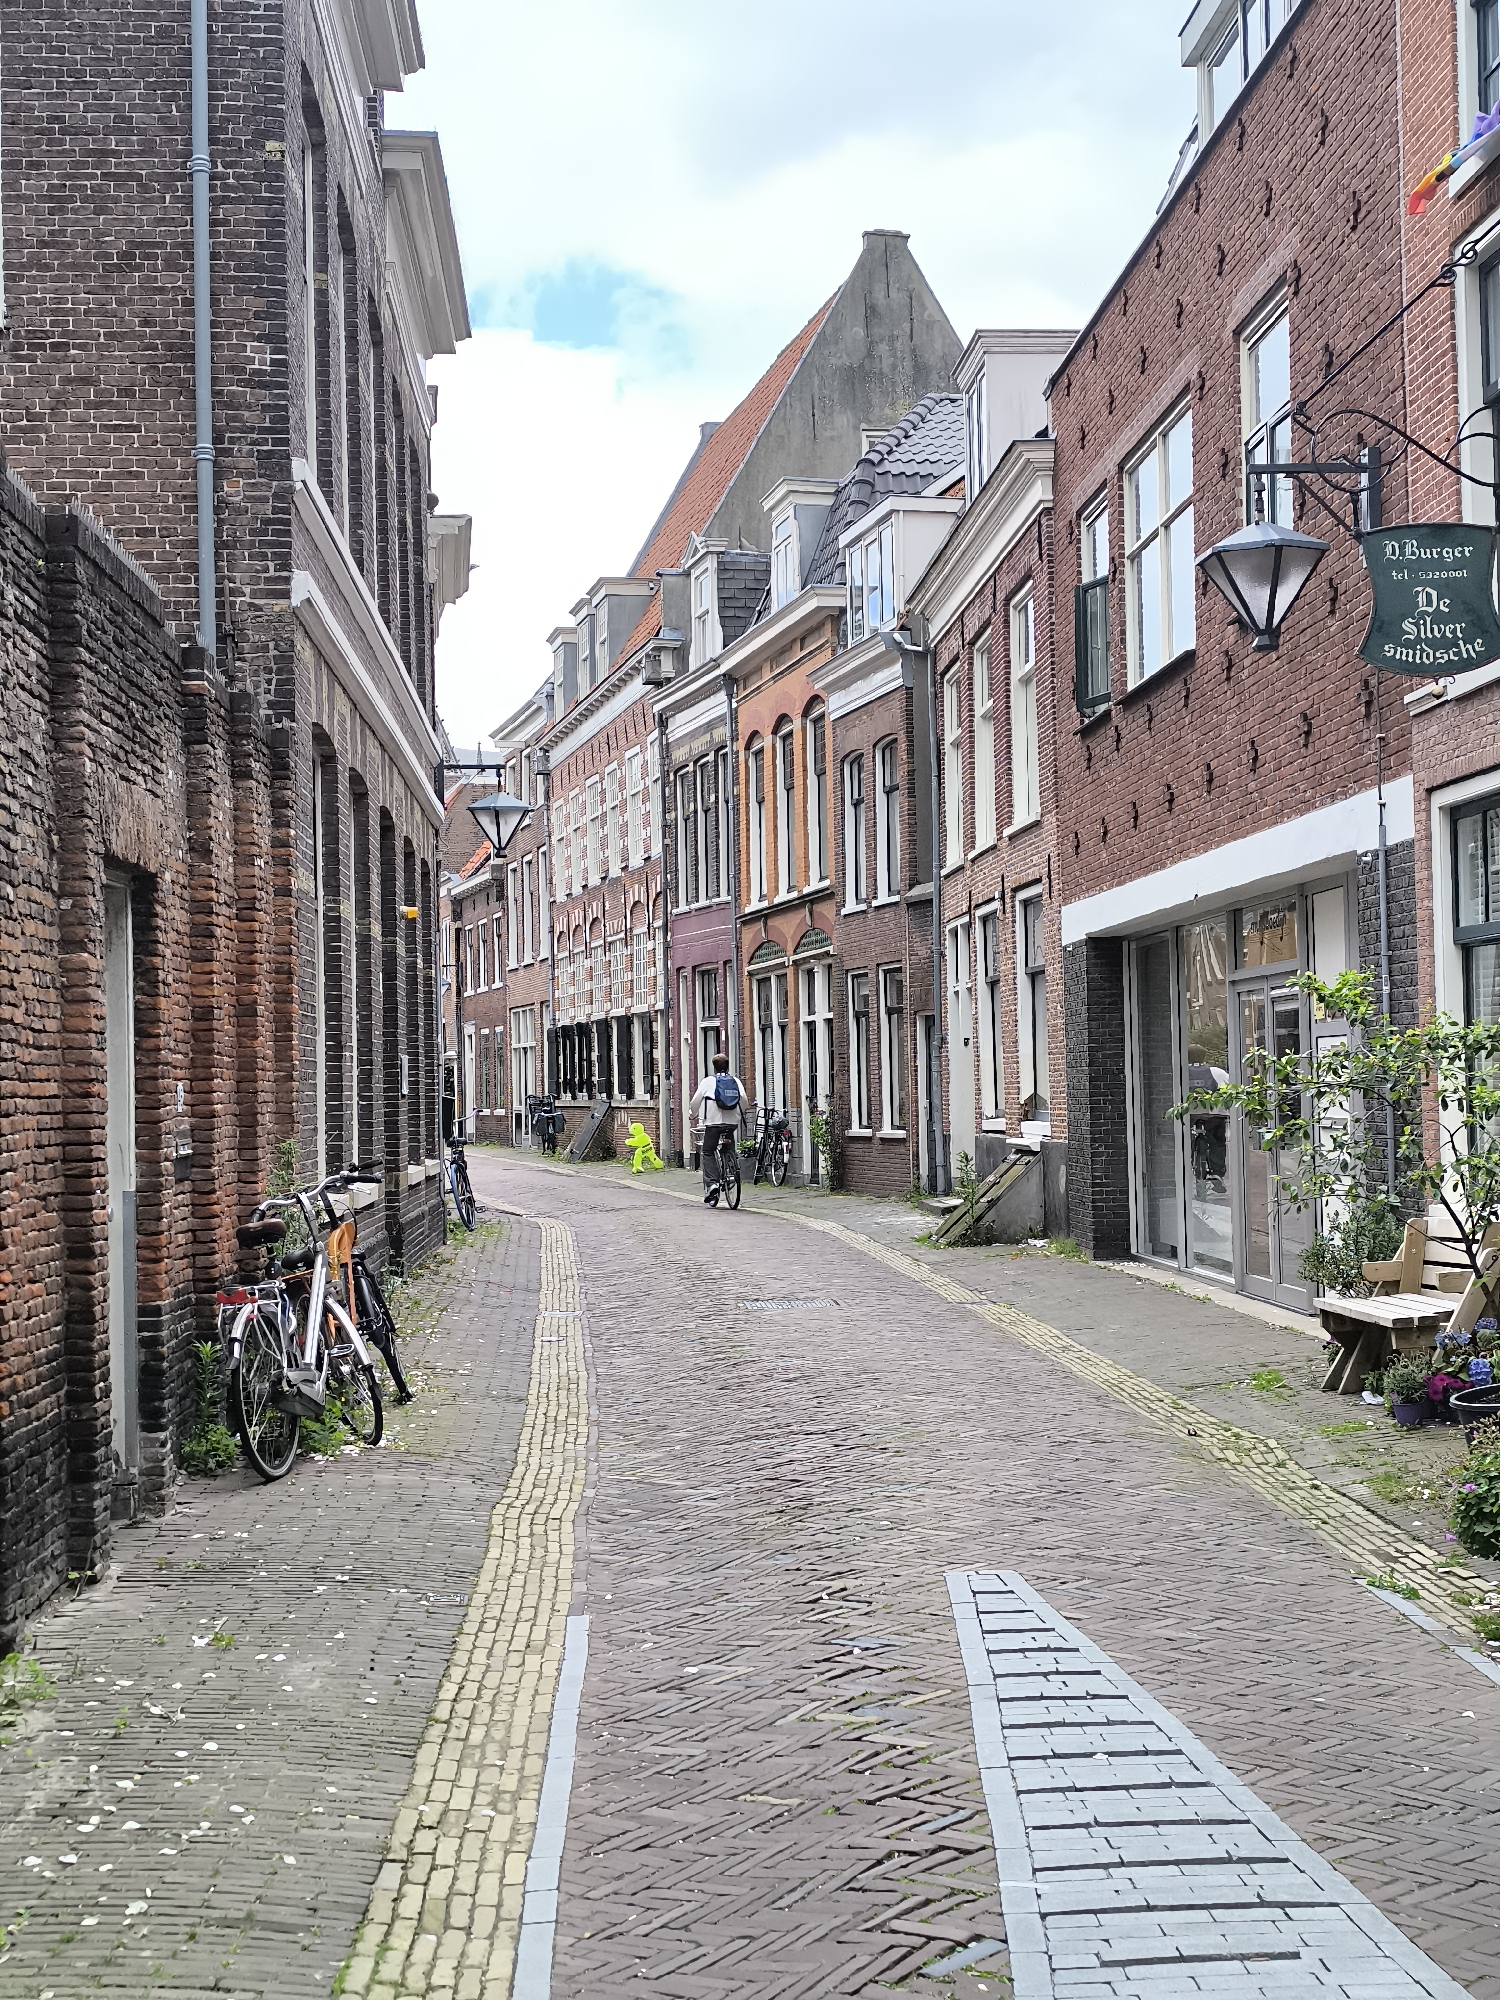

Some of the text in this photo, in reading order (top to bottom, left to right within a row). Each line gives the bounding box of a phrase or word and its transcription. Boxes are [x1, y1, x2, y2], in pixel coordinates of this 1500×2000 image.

[1412, 586, 1451, 620] De
[1401, 614, 1466, 644] Silver
[1380, 638, 1486, 666] smidsche
